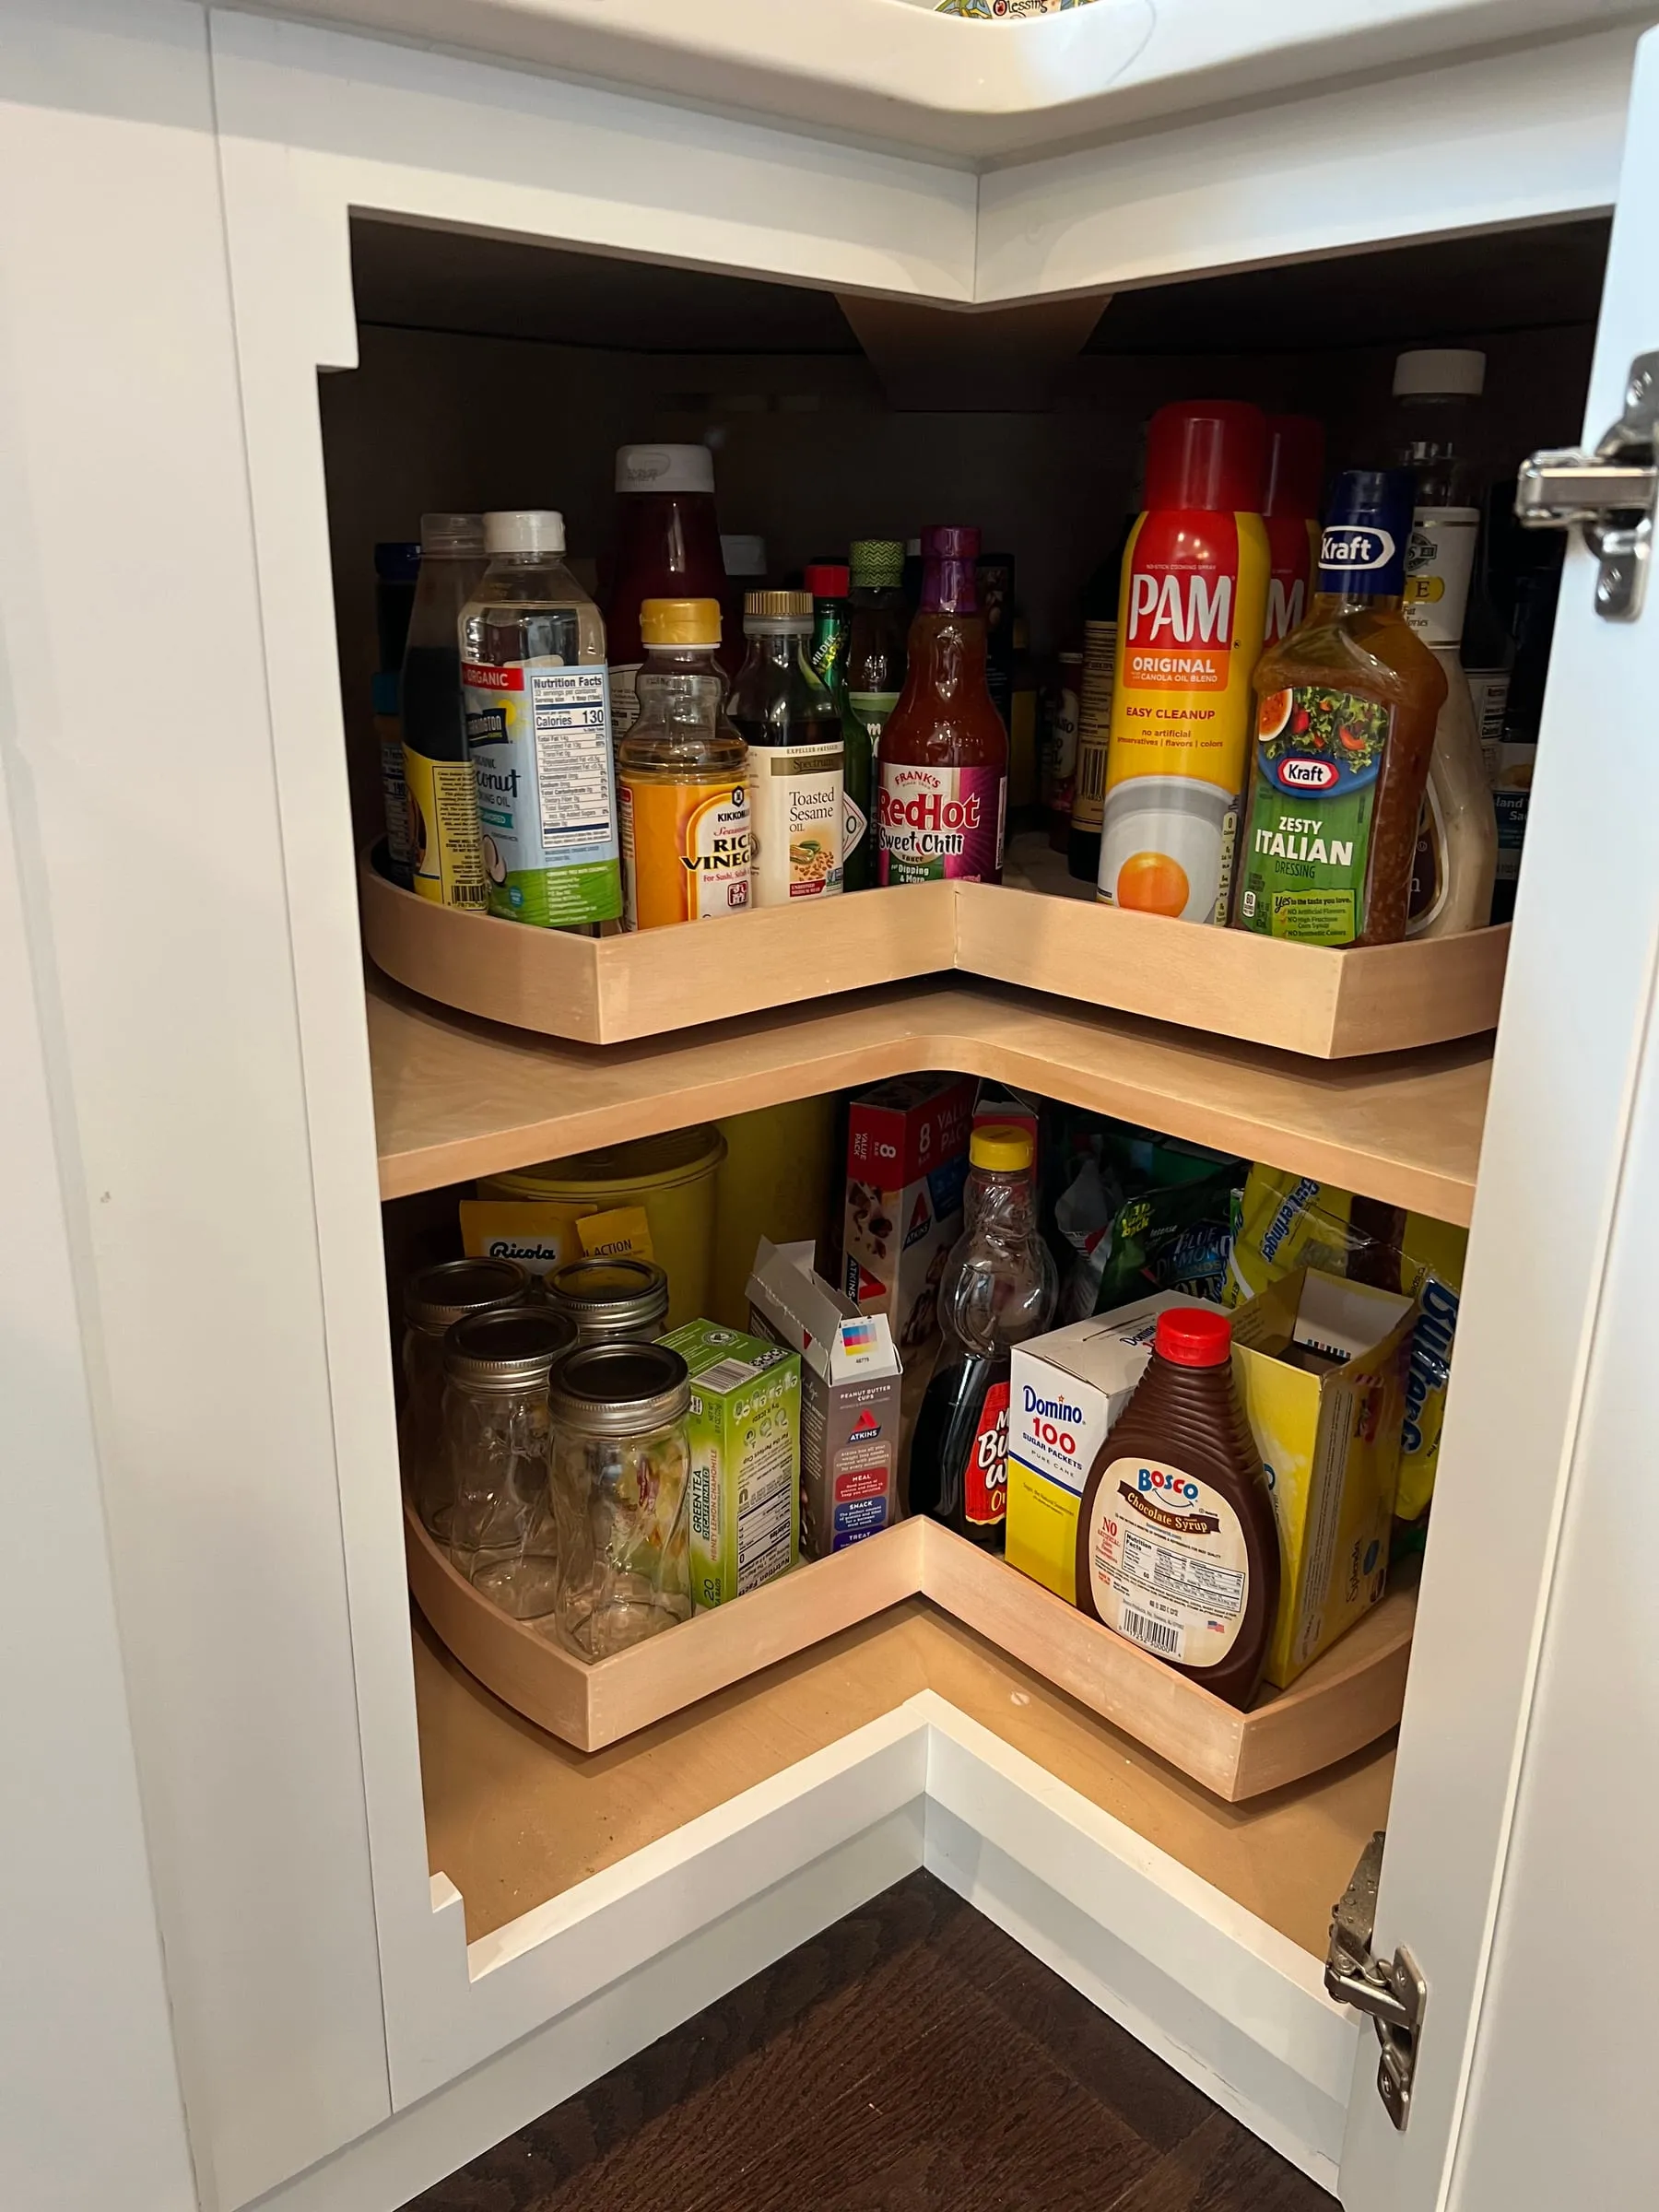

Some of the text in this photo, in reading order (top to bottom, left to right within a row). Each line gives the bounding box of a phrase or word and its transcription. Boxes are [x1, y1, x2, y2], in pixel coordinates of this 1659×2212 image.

[1321, 536, 1371, 560] Kraft
[1128, 574, 1232, 643] PAM
[1406, 617, 1429, 628] lories
[812, 633, 836, 665] MILDER
[1133, 656, 1216, 674] ORIGINAL
[466, 668, 509, 687] ORGANIC
[534, 677, 603, 688] Nutrition Facts
[1141, 673, 1218, 683] CANOLA OIL BLEND
[536, 709, 604, 727] Calories 130
[1126, 706, 1216, 720] EASY CLEANUP
[1154, 730, 1191, 738] artificial
[1165, 739, 1193, 747] flavors
[787, 747, 816, 755] EXPELLER
[793, 758, 834, 771] Spectrum
[1288, 763, 1324, 782] Kraft
[894, 771, 941, 789] FRANK'S
[496, 795, 512, 807] OIL
[789, 787, 835, 806] Toasted
[1497, 795, 1524, 808] land
[789, 806, 833, 822] Sesame
[878, 786, 981, 831] RedHot
[789, 824, 806, 833] OIL
[1279, 817, 1323, 835] ZESTY
[713, 834, 750, 853] RIC
[879, 828, 963, 854] Sweet Chili
[1255, 829, 1353, 866] ITALIAN
[704, 874, 715, 883] For
[898, 863, 929, 876] Dipping
[1275, 861, 1316, 879] DRESSING
[936, 1103, 969, 1130] VALU
[853, 1133, 862, 1157] PACK
[860, 1132, 868, 1161] VALUE
[920, 1123, 931, 1152] 8
[879, 1144, 896, 1159] 8
[905, 1220, 930, 1245] ATKINS
[488, 1241, 556, 1260] Ricola
[594, 1239, 632, 1257] ACTION
[848, 1259, 857, 1300] ATKINS
[841, 1384, 891, 1400] PEANUT BUTTER
[857, 1394, 875, 1402] CUPS
[771, 1403, 781, 1411] Try
[1023, 1384, 1082, 1425] Domino
[780, 1434, 789, 1444] For
[850, 1430, 877, 1441] ATKINS
[1032, 1417, 1077, 1454] 100
[743, 1454, 753, 1465] Cup
[754, 1444, 771, 1459] Perfect
[1023, 1432, 1082, 1471] SUGAR PACKETS
[1030, 1449, 1075, 1478] PURE CANE
[1137, 1469, 1198, 1500] BOSCO
[693, 1470, 702, 1534] GREEN TEA
[850, 1500, 874, 1511] SNACK
[1126, 1492, 1207, 1534] Chocolate Syrup
[1102, 1517, 1118, 1537] NO
[740, 1522, 791, 1563] Calories 0
[850, 1532, 871, 1541] TREAT
[1126, 1534, 1152, 1550] Nutrition
[1126, 1539, 1143, 1552] Facts
[737, 1558, 790, 1597] Nutrition Facts
[704, 1578, 714, 1601] 20
